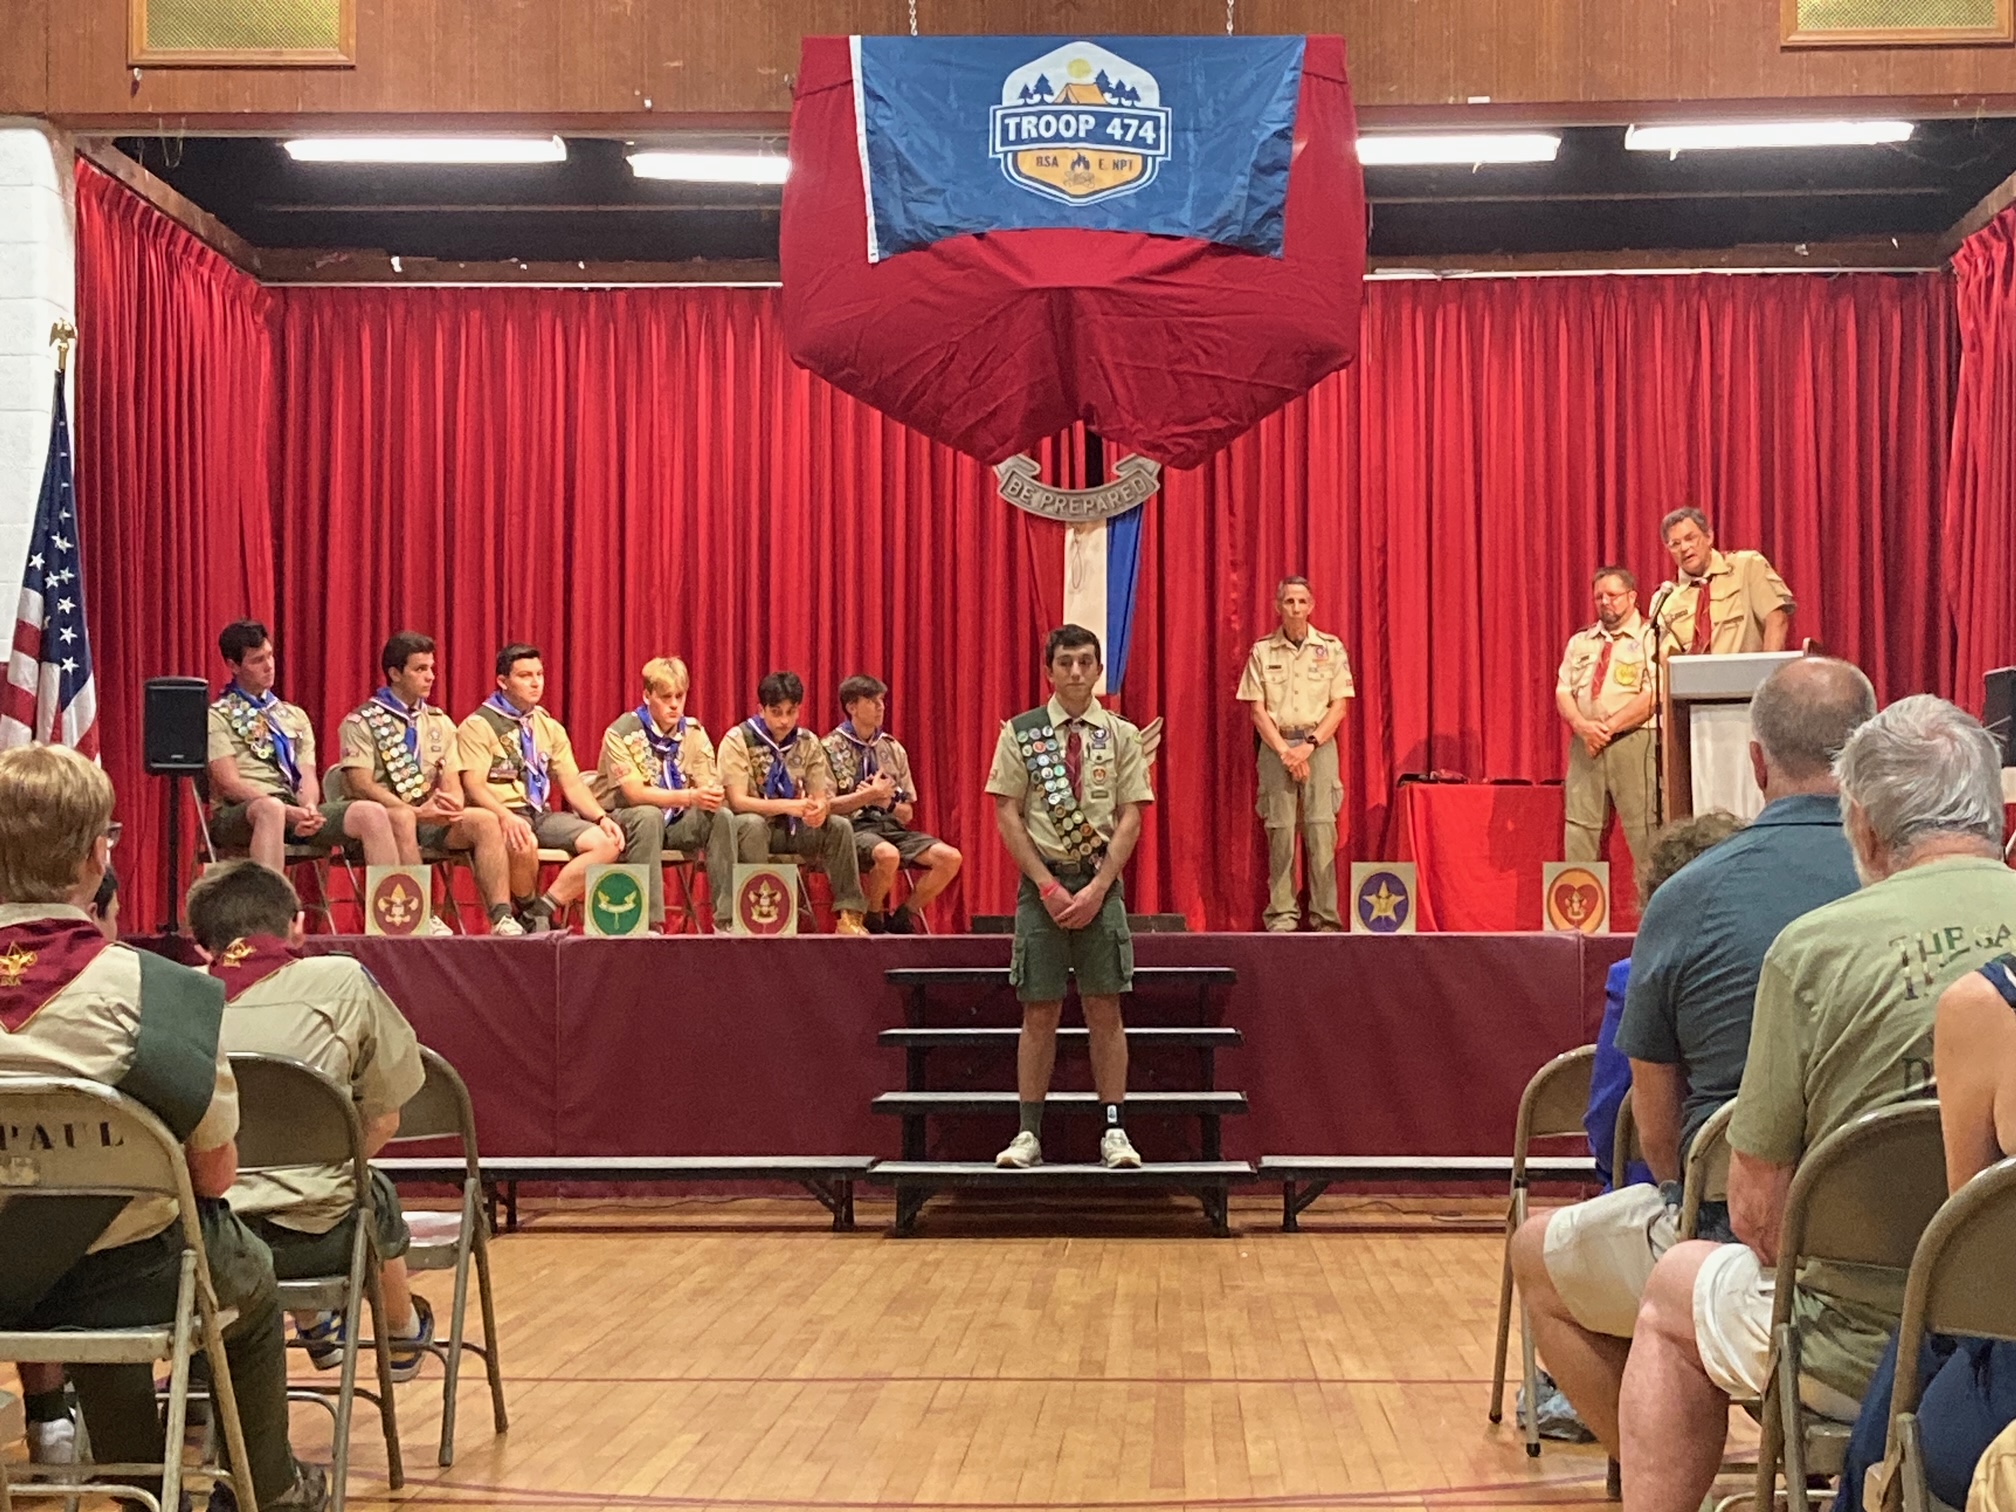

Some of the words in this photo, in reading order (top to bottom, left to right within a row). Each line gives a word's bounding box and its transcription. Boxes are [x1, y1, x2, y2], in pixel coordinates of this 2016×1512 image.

[1004, 114, 1096, 141] TROOP
[1105, 117, 1157, 145] 474
[1035, 155, 1060, 168] BSA
[1112, 159, 1134, 172] NPT
[1007, 478, 1036, 502] BE
[1040, 477, 1148, 515] PREPARED
[0, 1121, 125, 1151] PAUL
